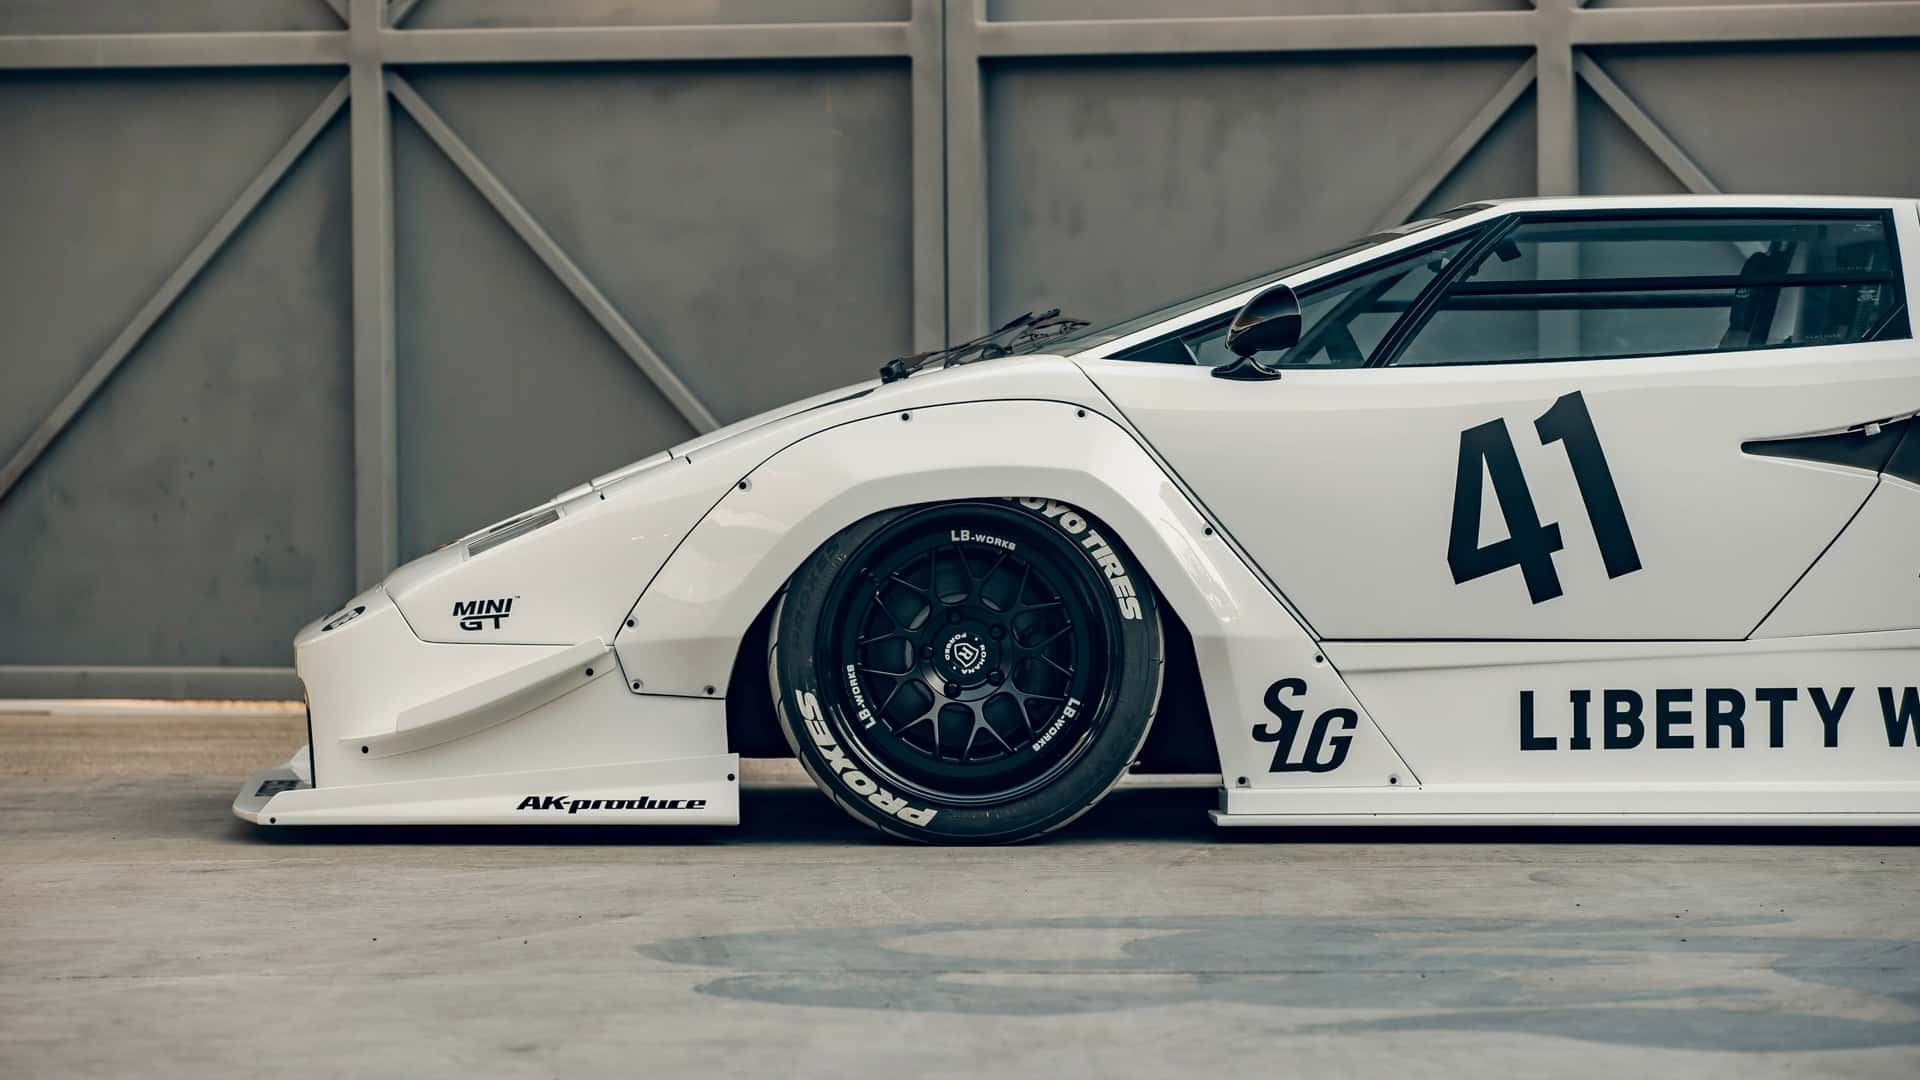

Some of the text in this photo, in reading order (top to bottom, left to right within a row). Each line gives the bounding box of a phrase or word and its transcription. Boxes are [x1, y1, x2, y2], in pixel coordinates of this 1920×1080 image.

[1447, 390, 1642, 605] 41
[950, 529, 1016, 551] LB-WORKS
[1002, 497, 1143, 620] OYO TIRES
[453, 598, 513, 616] MINI
[460, 613, 510, 631] GT
[846, 663, 877, 730] LB-WORKS
[1032, 697, 1081, 752] LB-WORKS
[1252, 677, 1358, 773] SLG
[1519, 686, 1856, 751] LIBERTY
[795, 689, 938, 826] PROXES
[516, 795, 707, 814] AK-produce
